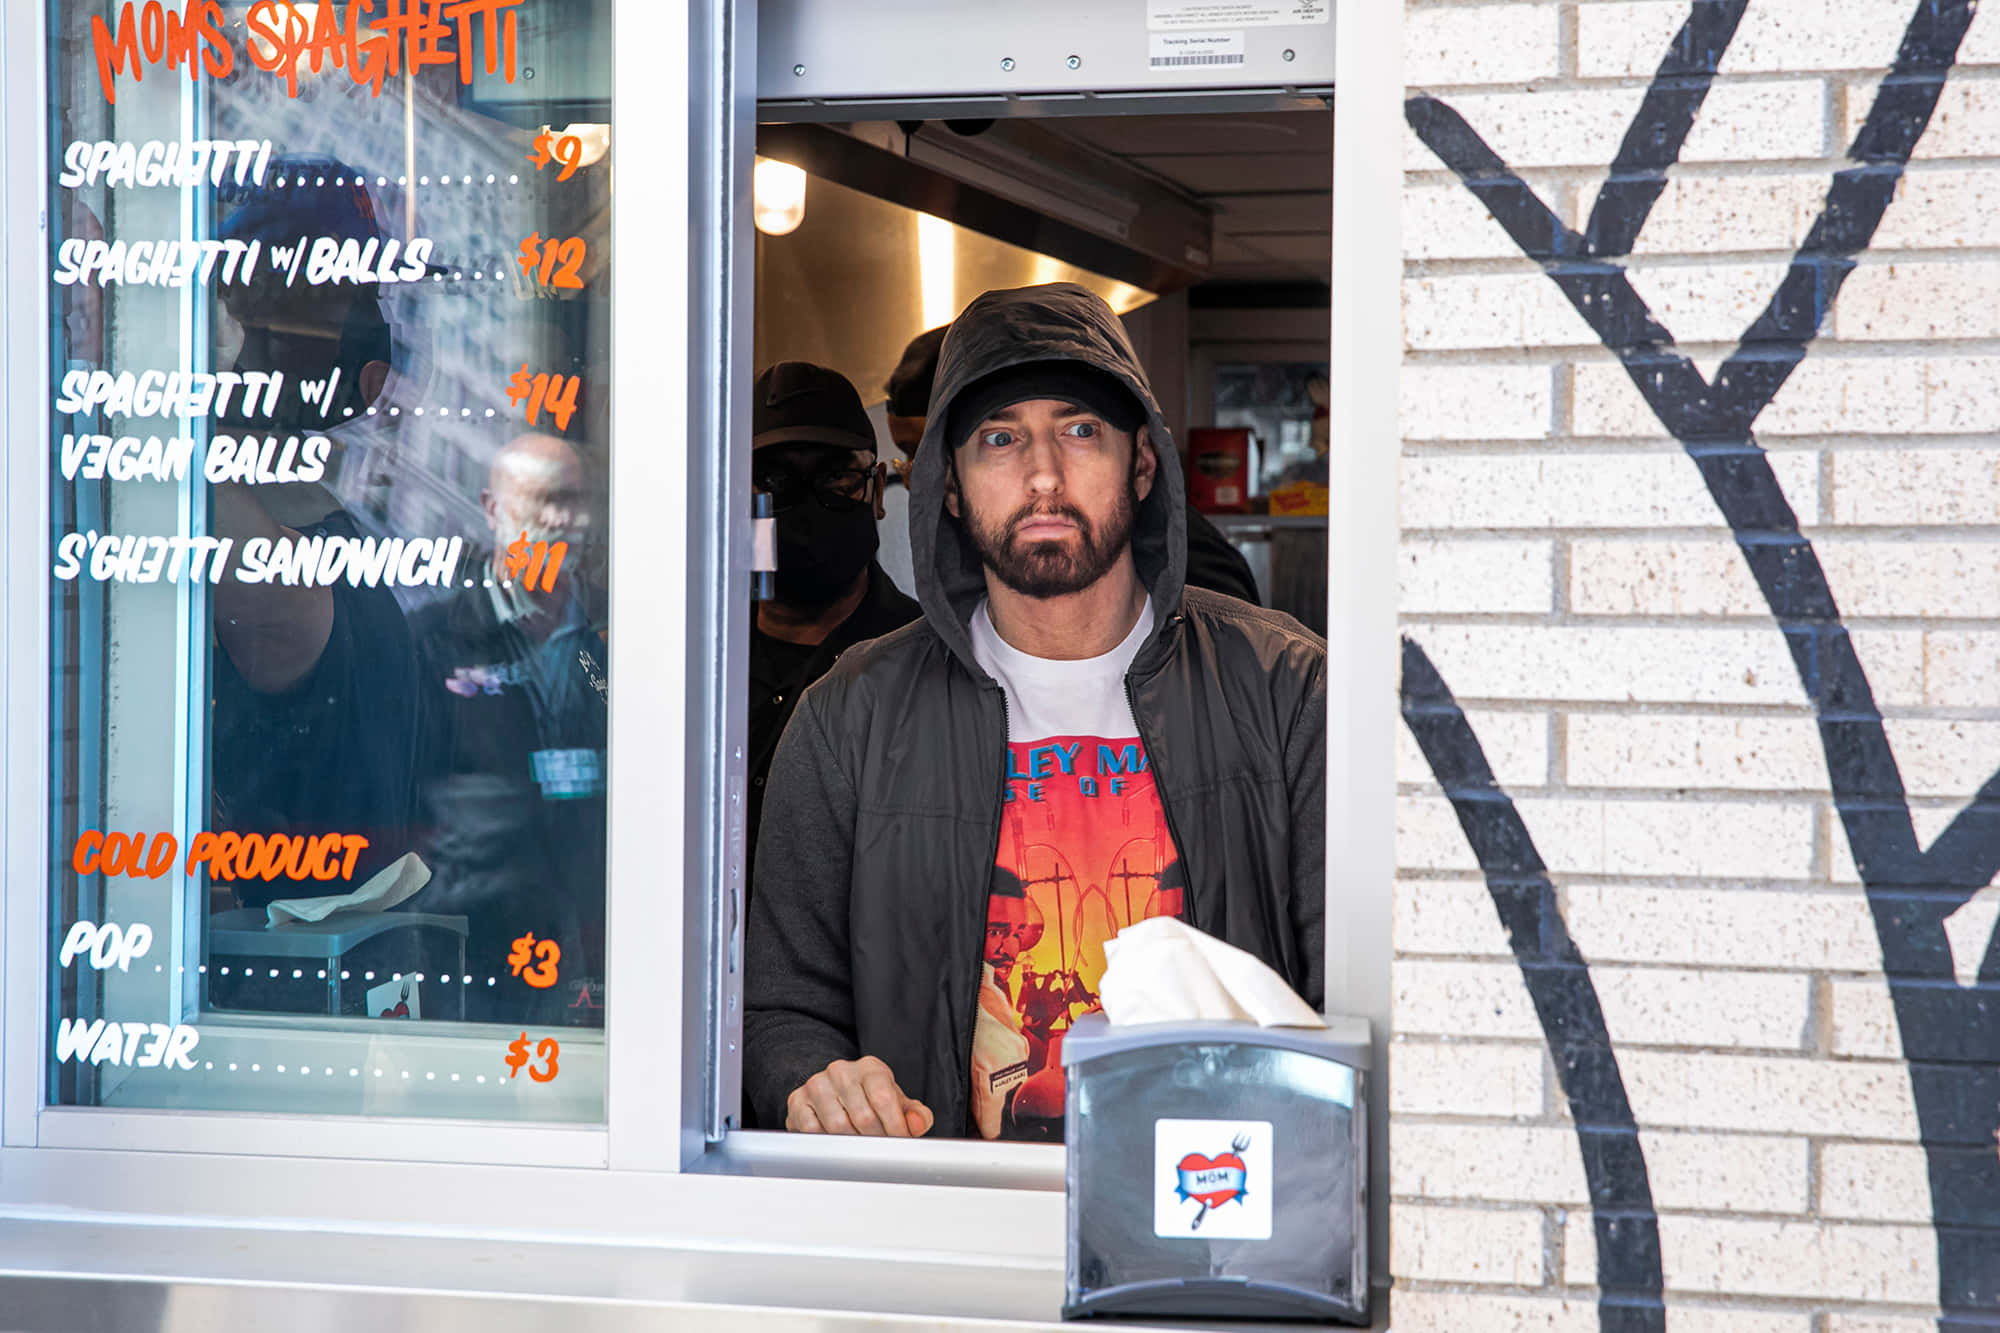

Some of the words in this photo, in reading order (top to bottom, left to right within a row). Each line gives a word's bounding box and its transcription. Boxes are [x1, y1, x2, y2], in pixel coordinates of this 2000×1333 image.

[91, 0, 234, 104] MOMS
[246, 0, 525, 98] SPAGHETTI
[527, 129, 583, 182] $9
[518, 231, 587, 290] $12
[505, 363, 581, 431] $14
[203, 435, 332, 484] BALLS
[234, 535, 463, 588] SANDWICH
[505, 530, 569, 594] $11
[1079, 776, 1129, 797] OF
[72, 829, 178, 880] COLD
[186, 830, 370, 881] PRODUCT
[59, 921, 153, 972] POP
[507, 931, 562, 989] $3
[505, 1031, 561, 1083] $3
[1196, 1171, 1229, 1186] MOM
